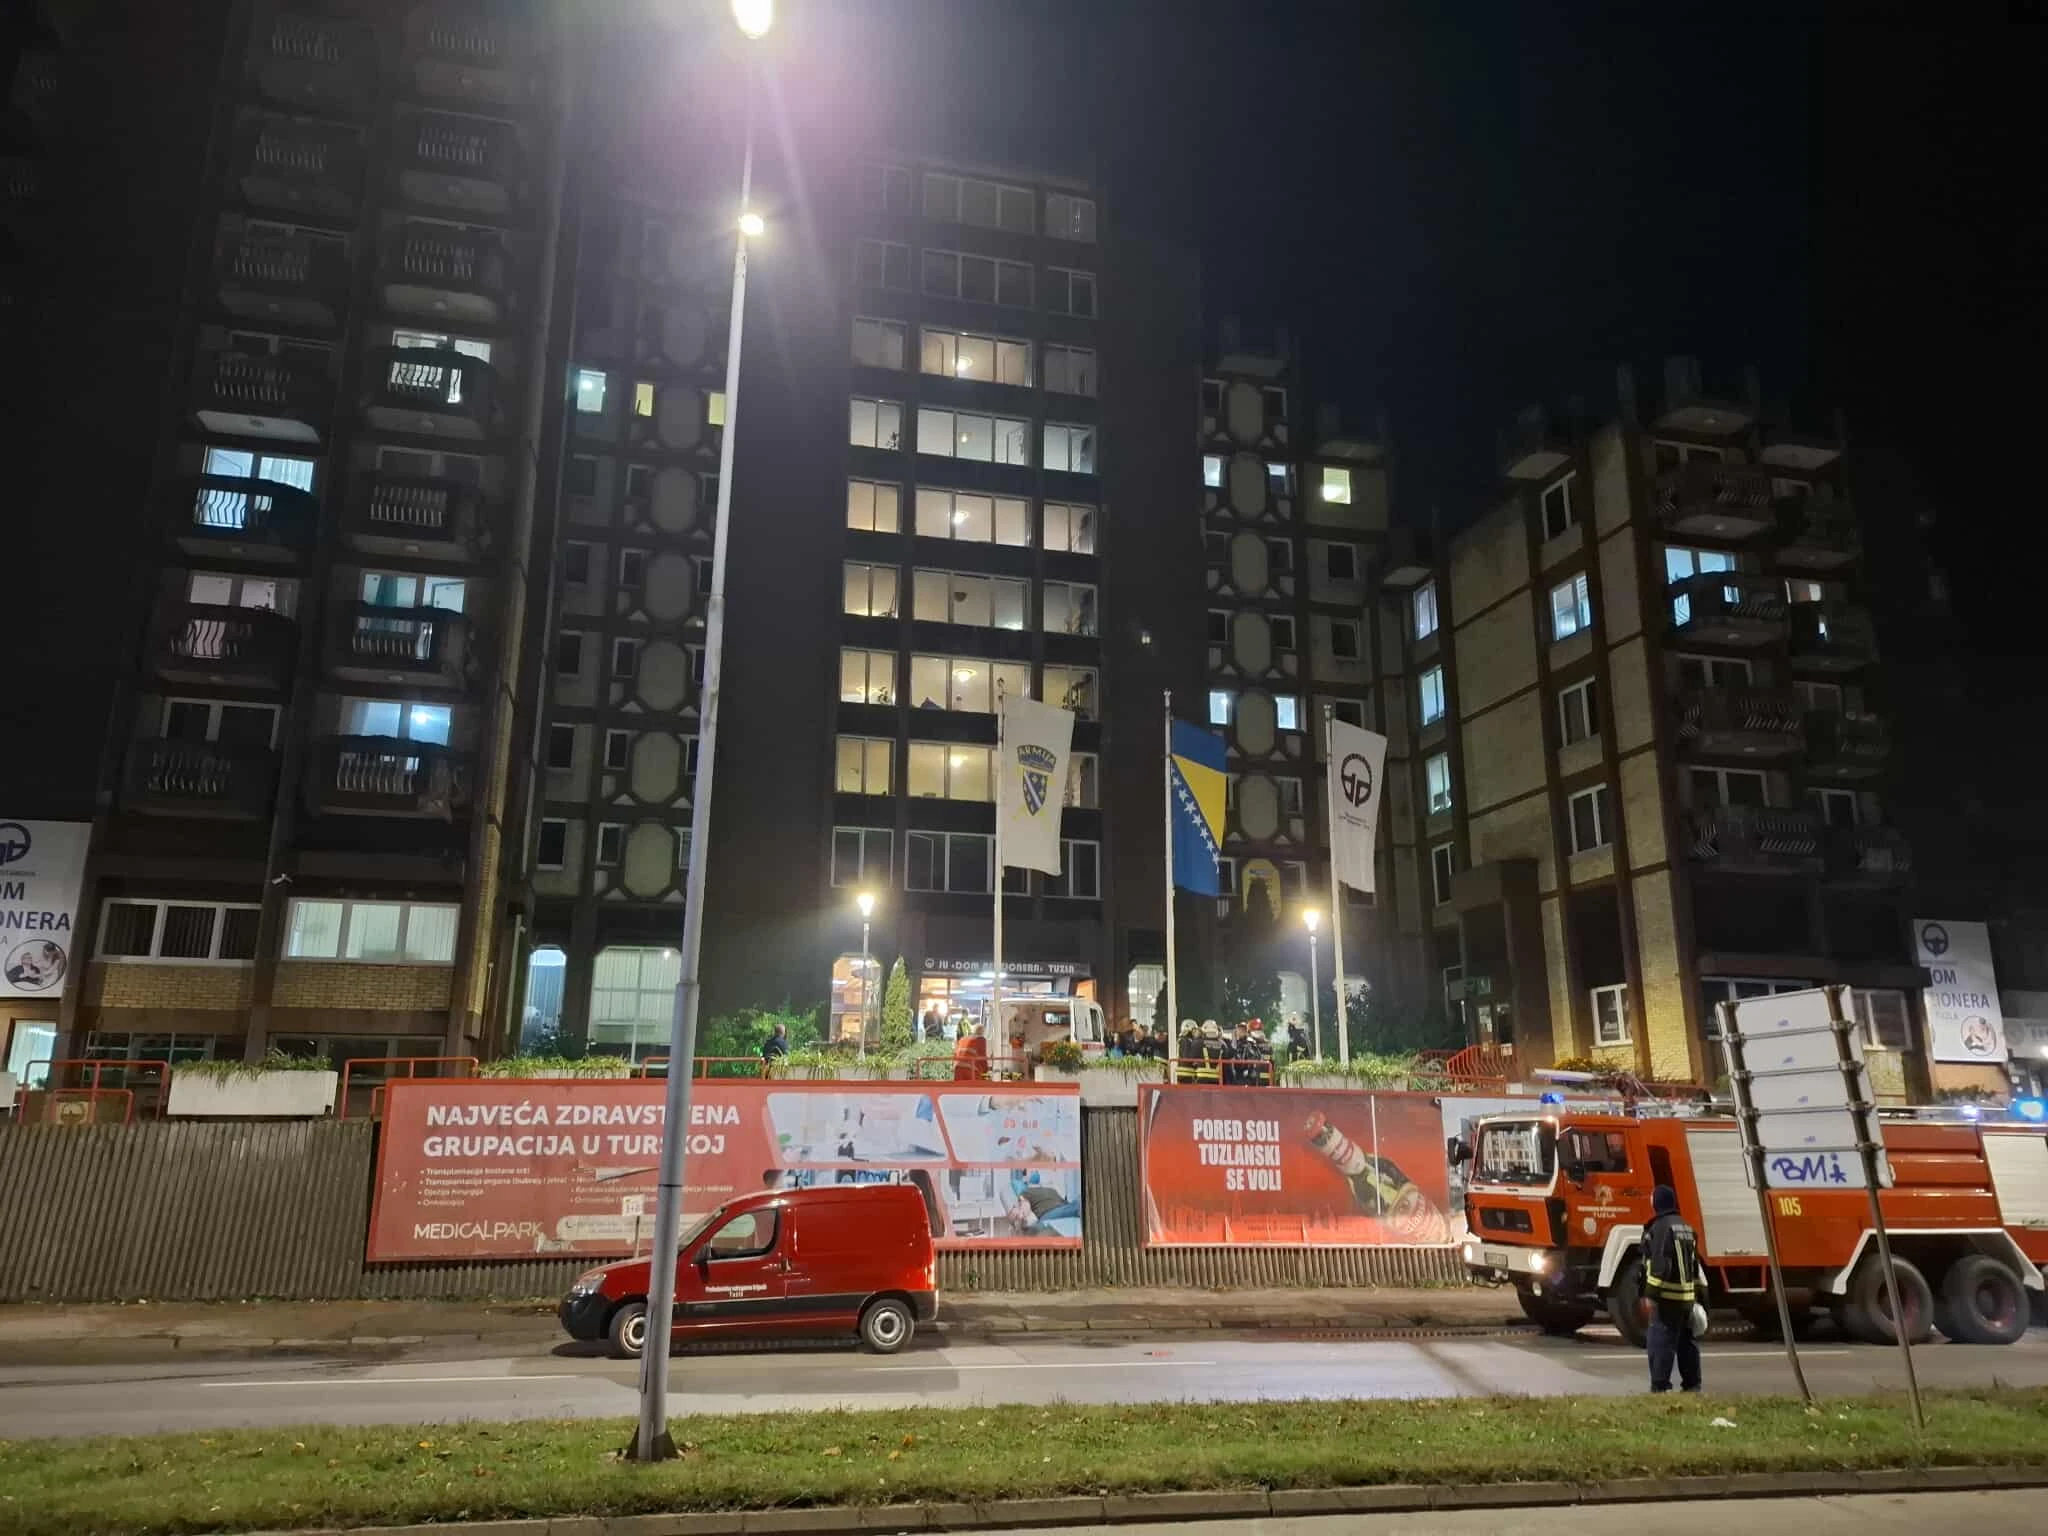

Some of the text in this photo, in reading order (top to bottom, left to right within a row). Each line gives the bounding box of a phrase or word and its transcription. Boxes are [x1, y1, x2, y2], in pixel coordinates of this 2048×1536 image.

[0, 881, 25, 900] M
[0, 910, 70, 930] NERA
[1932, 968, 1957, 985] OM
[427, 1101, 741, 1126] NAJVEĆA ZDRAVSTENA
[1193, 1119, 1280, 1142] PORED SOLI
[423, 1134, 726, 1157] GRUPACIJA U TUROJ
[1199, 1144, 1281, 1166] TUZLANSKI
[1226, 1168, 1282, 1191] SE VOLI
[1779, 1197, 1802, 1216] 105
